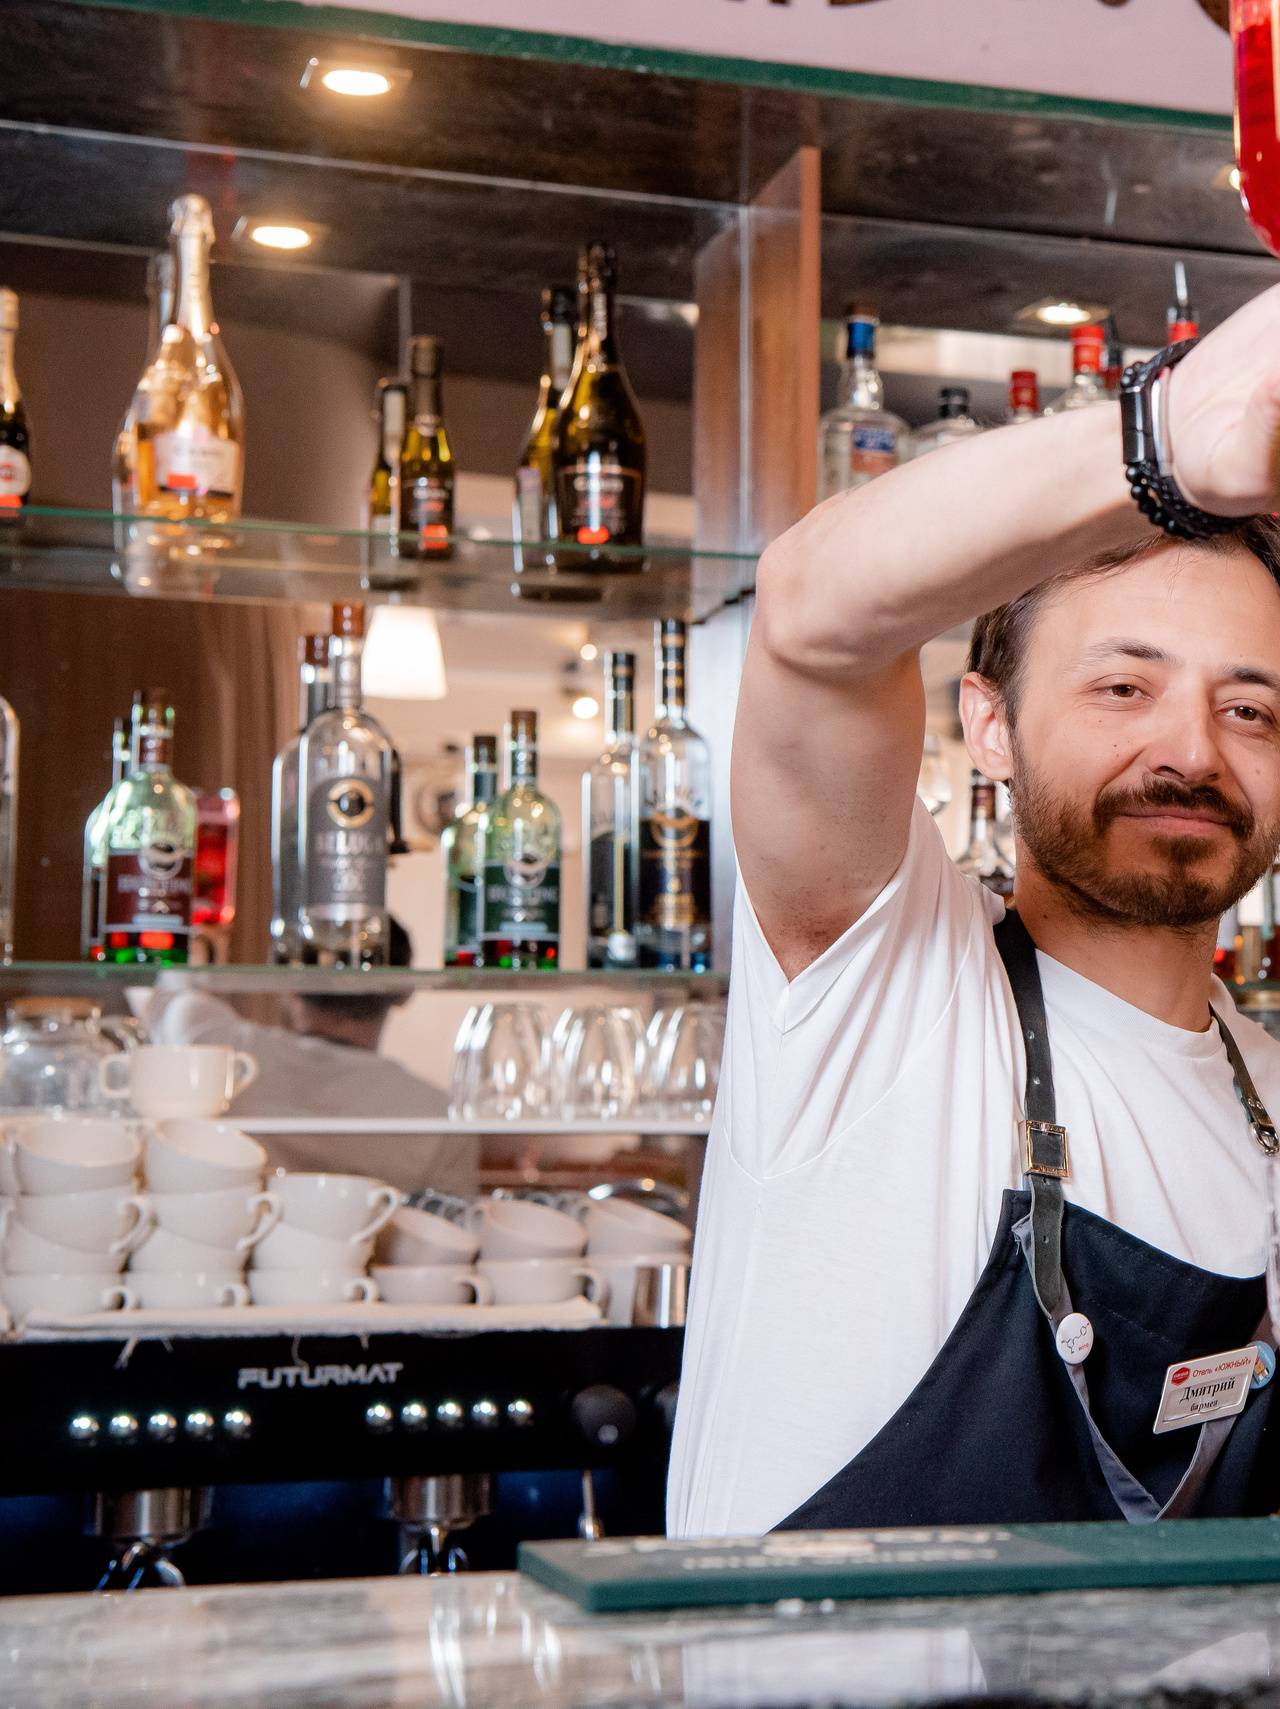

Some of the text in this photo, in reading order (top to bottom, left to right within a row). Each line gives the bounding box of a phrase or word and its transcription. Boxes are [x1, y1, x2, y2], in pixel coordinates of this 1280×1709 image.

[237, 1361, 404, 1390] FUTURMAT
[1192, 1367, 1213, 1378] Отель
[1214, 1357, 1252, 1373] «ЮЖНЫЙ»
[1179, 1376, 1236, 1403] Дмитрий
[1190, 1399, 1219, 1412] бармен
